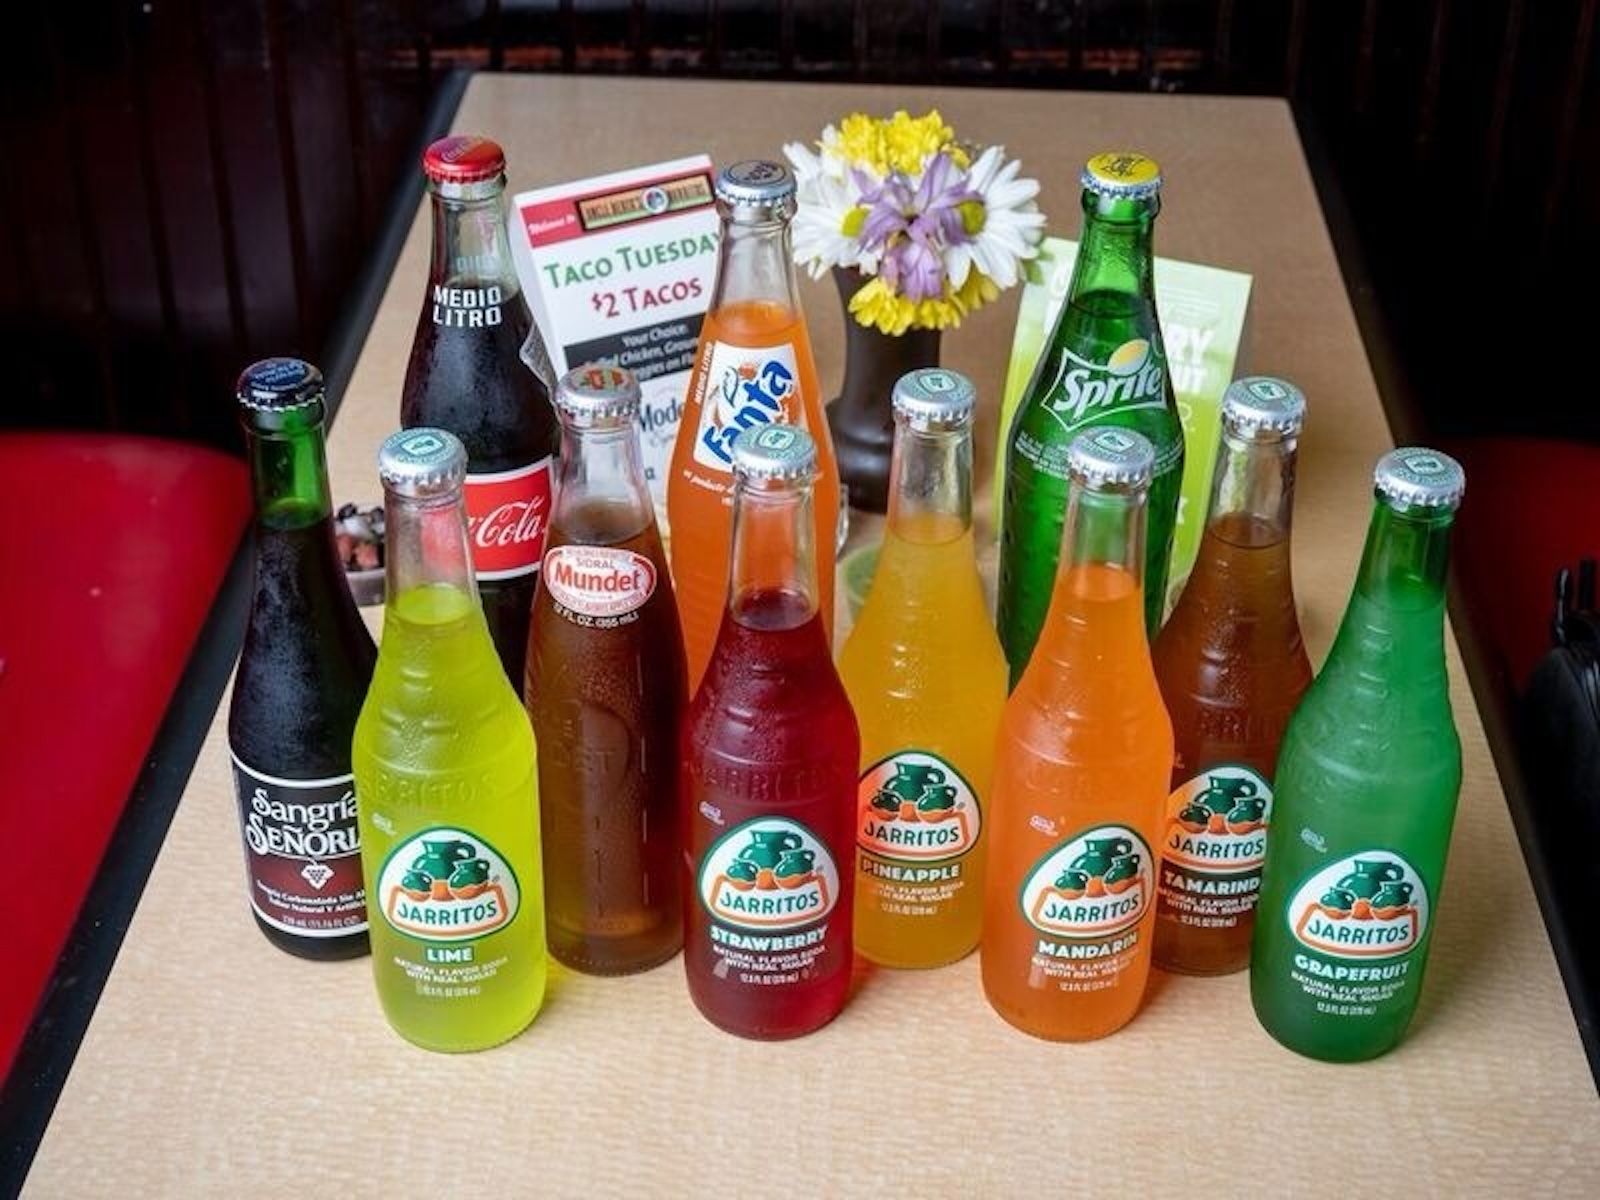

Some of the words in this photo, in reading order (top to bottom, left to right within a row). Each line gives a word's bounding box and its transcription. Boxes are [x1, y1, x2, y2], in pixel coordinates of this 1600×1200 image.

[543, 257, 613, 289] TACO
[433, 285, 502, 308] MEDIO
[592, 291, 620, 318] $2
[622, 278, 703, 312] TACOS
[433, 304, 503, 328] LITRO
[622, 333, 649, 347] Your
[1053, 357, 1162, 421] Sprite
[702, 360, 792, 464] Fanta
[555, 561, 641, 592] Mundet
[251, 788, 359, 832] Sangría
[245, 813, 362, 855] SEÑORI
[864, 821, 960, 847] JARRITOS
[1169, 834, 1264, 859] JARRITOS
[862, 858, 961, 883] PINEAPPLE
[1164, 870, 1260, 895] TAMARIND
[397, 901, 497, 925] JARRITOS
[720, 890, 820, 914] JARRITOS
[1045, 894, 1139, 922] JARRITOS
[710, 924, 829, 951] STRAWBERRY
[1039, 932, 1138, 959] MANDARIN
[1308, 920, 1410, 945] JARRITOS
[427, 948, 473, 962] LIME
[1295, 955, 1410, 982] GRAPEFRUIT
